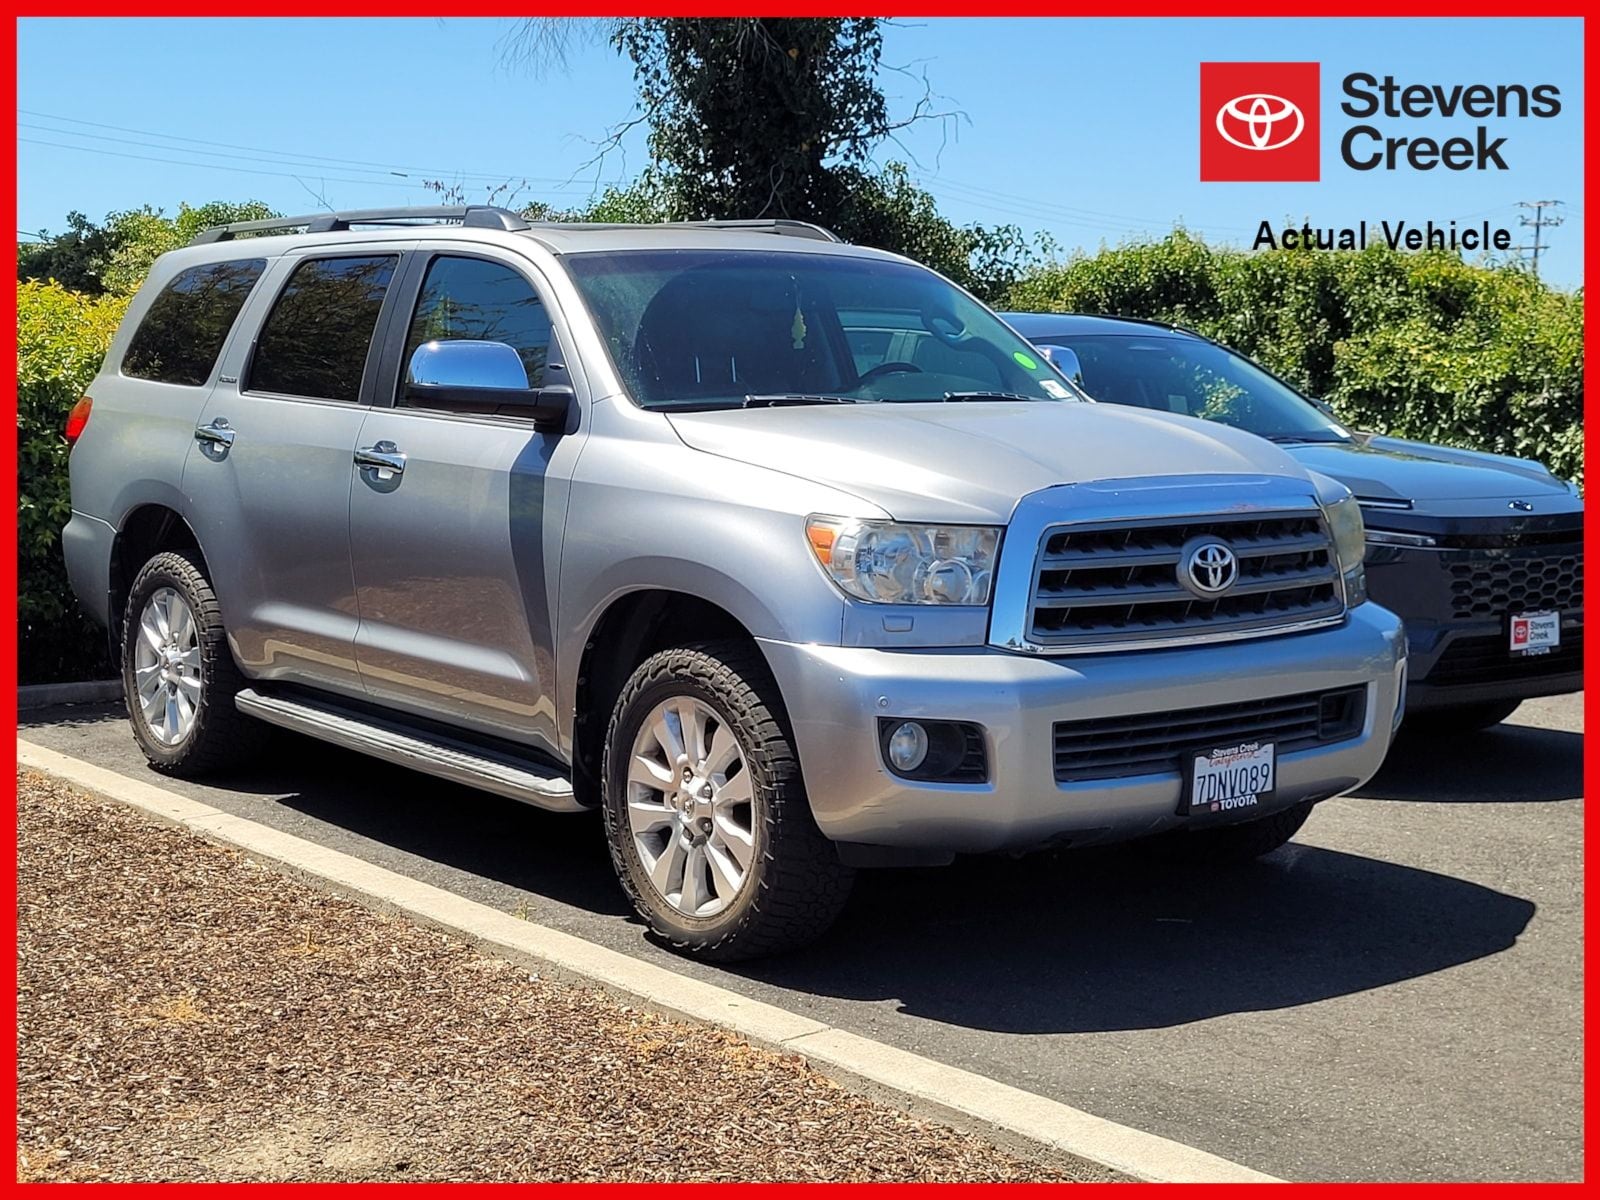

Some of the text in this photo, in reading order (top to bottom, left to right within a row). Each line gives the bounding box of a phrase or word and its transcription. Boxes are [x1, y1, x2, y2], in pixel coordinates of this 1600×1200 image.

[1212, 742, 1259, 758] Stevens Creek
[1196, 763, 1270, 804] 7DNV089
[1219, 794, 1258, 811] TOYOTA
